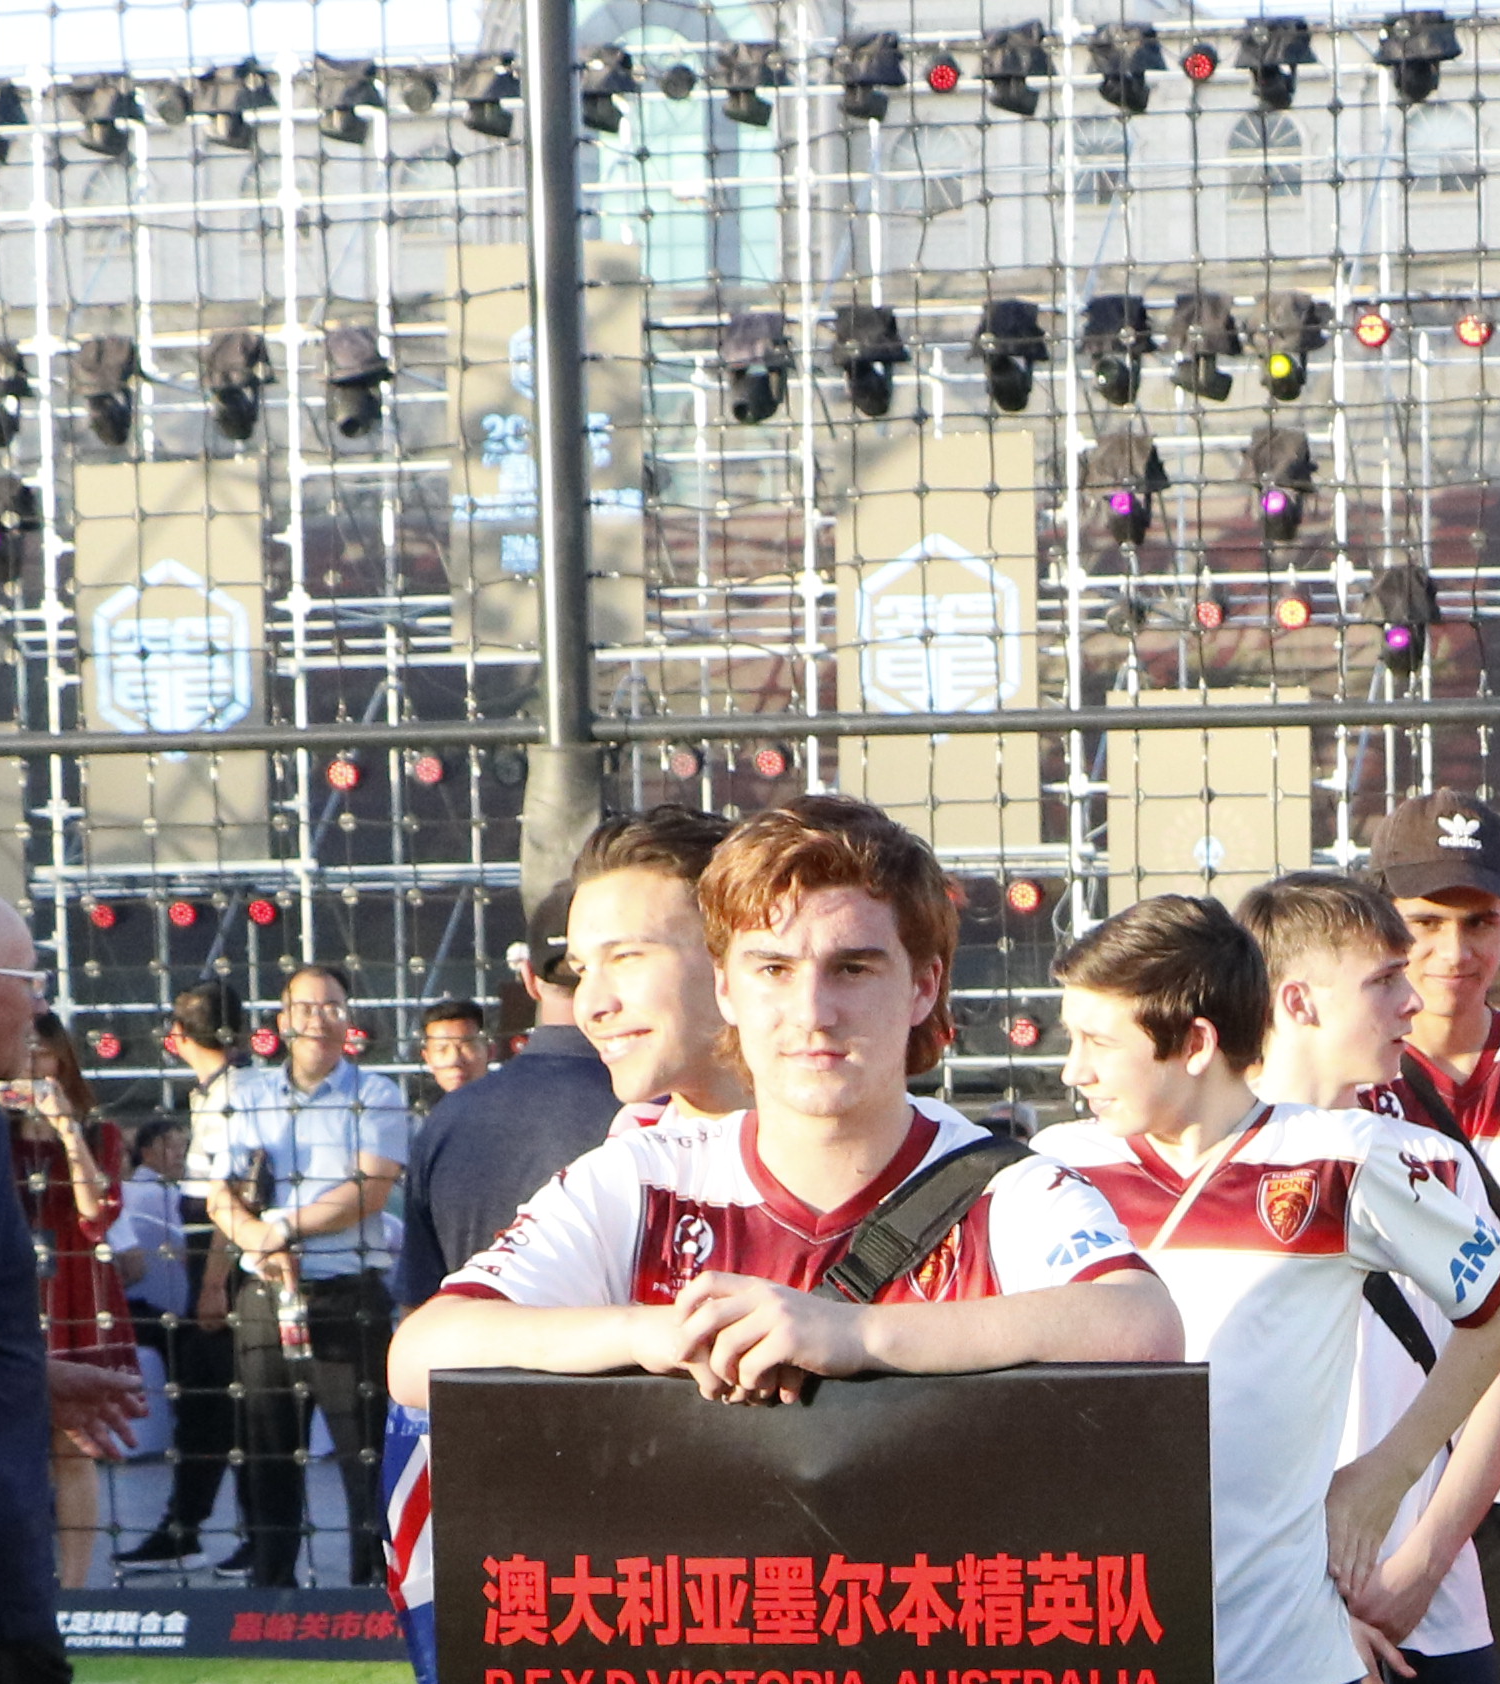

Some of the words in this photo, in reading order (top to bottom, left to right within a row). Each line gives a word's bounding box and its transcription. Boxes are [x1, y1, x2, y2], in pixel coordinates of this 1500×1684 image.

[482, 1553, 1164, 1647] 澳大利亚墨尔本精英队
